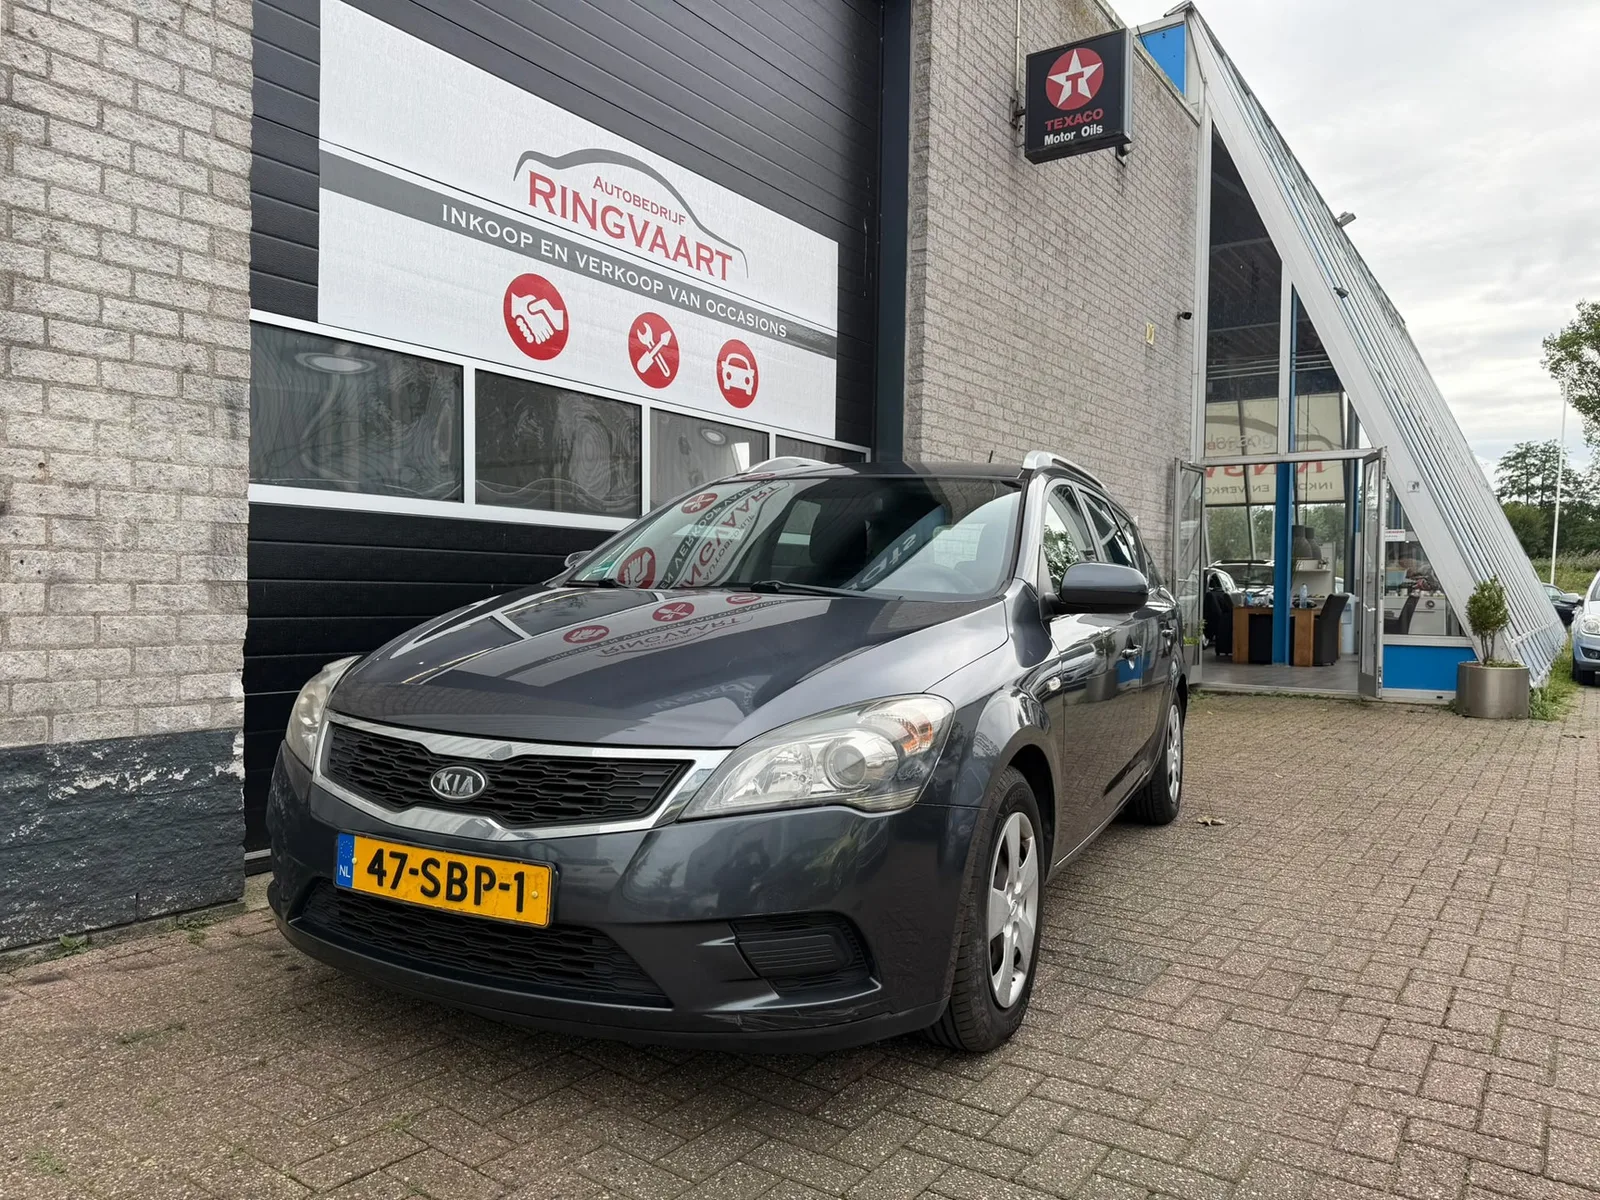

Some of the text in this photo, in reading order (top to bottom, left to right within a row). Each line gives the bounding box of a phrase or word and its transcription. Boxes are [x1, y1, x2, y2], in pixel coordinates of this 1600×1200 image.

[1044, 124, 1103, 145] Motor Oils
[1045, 108, 1104, 131] TEXACO
[593, 176, 686, 226] AUTOBEDRIJF
[528, 170, 733, 281] RINGVAART
[442, 204, 788, 338] INKOOP EN VERKOOP VAN OCCASIONS
[437, 771, 474, 794] KIA
[339, 864, 351, 878] NL
[366, 848, 525, 913] 47-SBP-1
